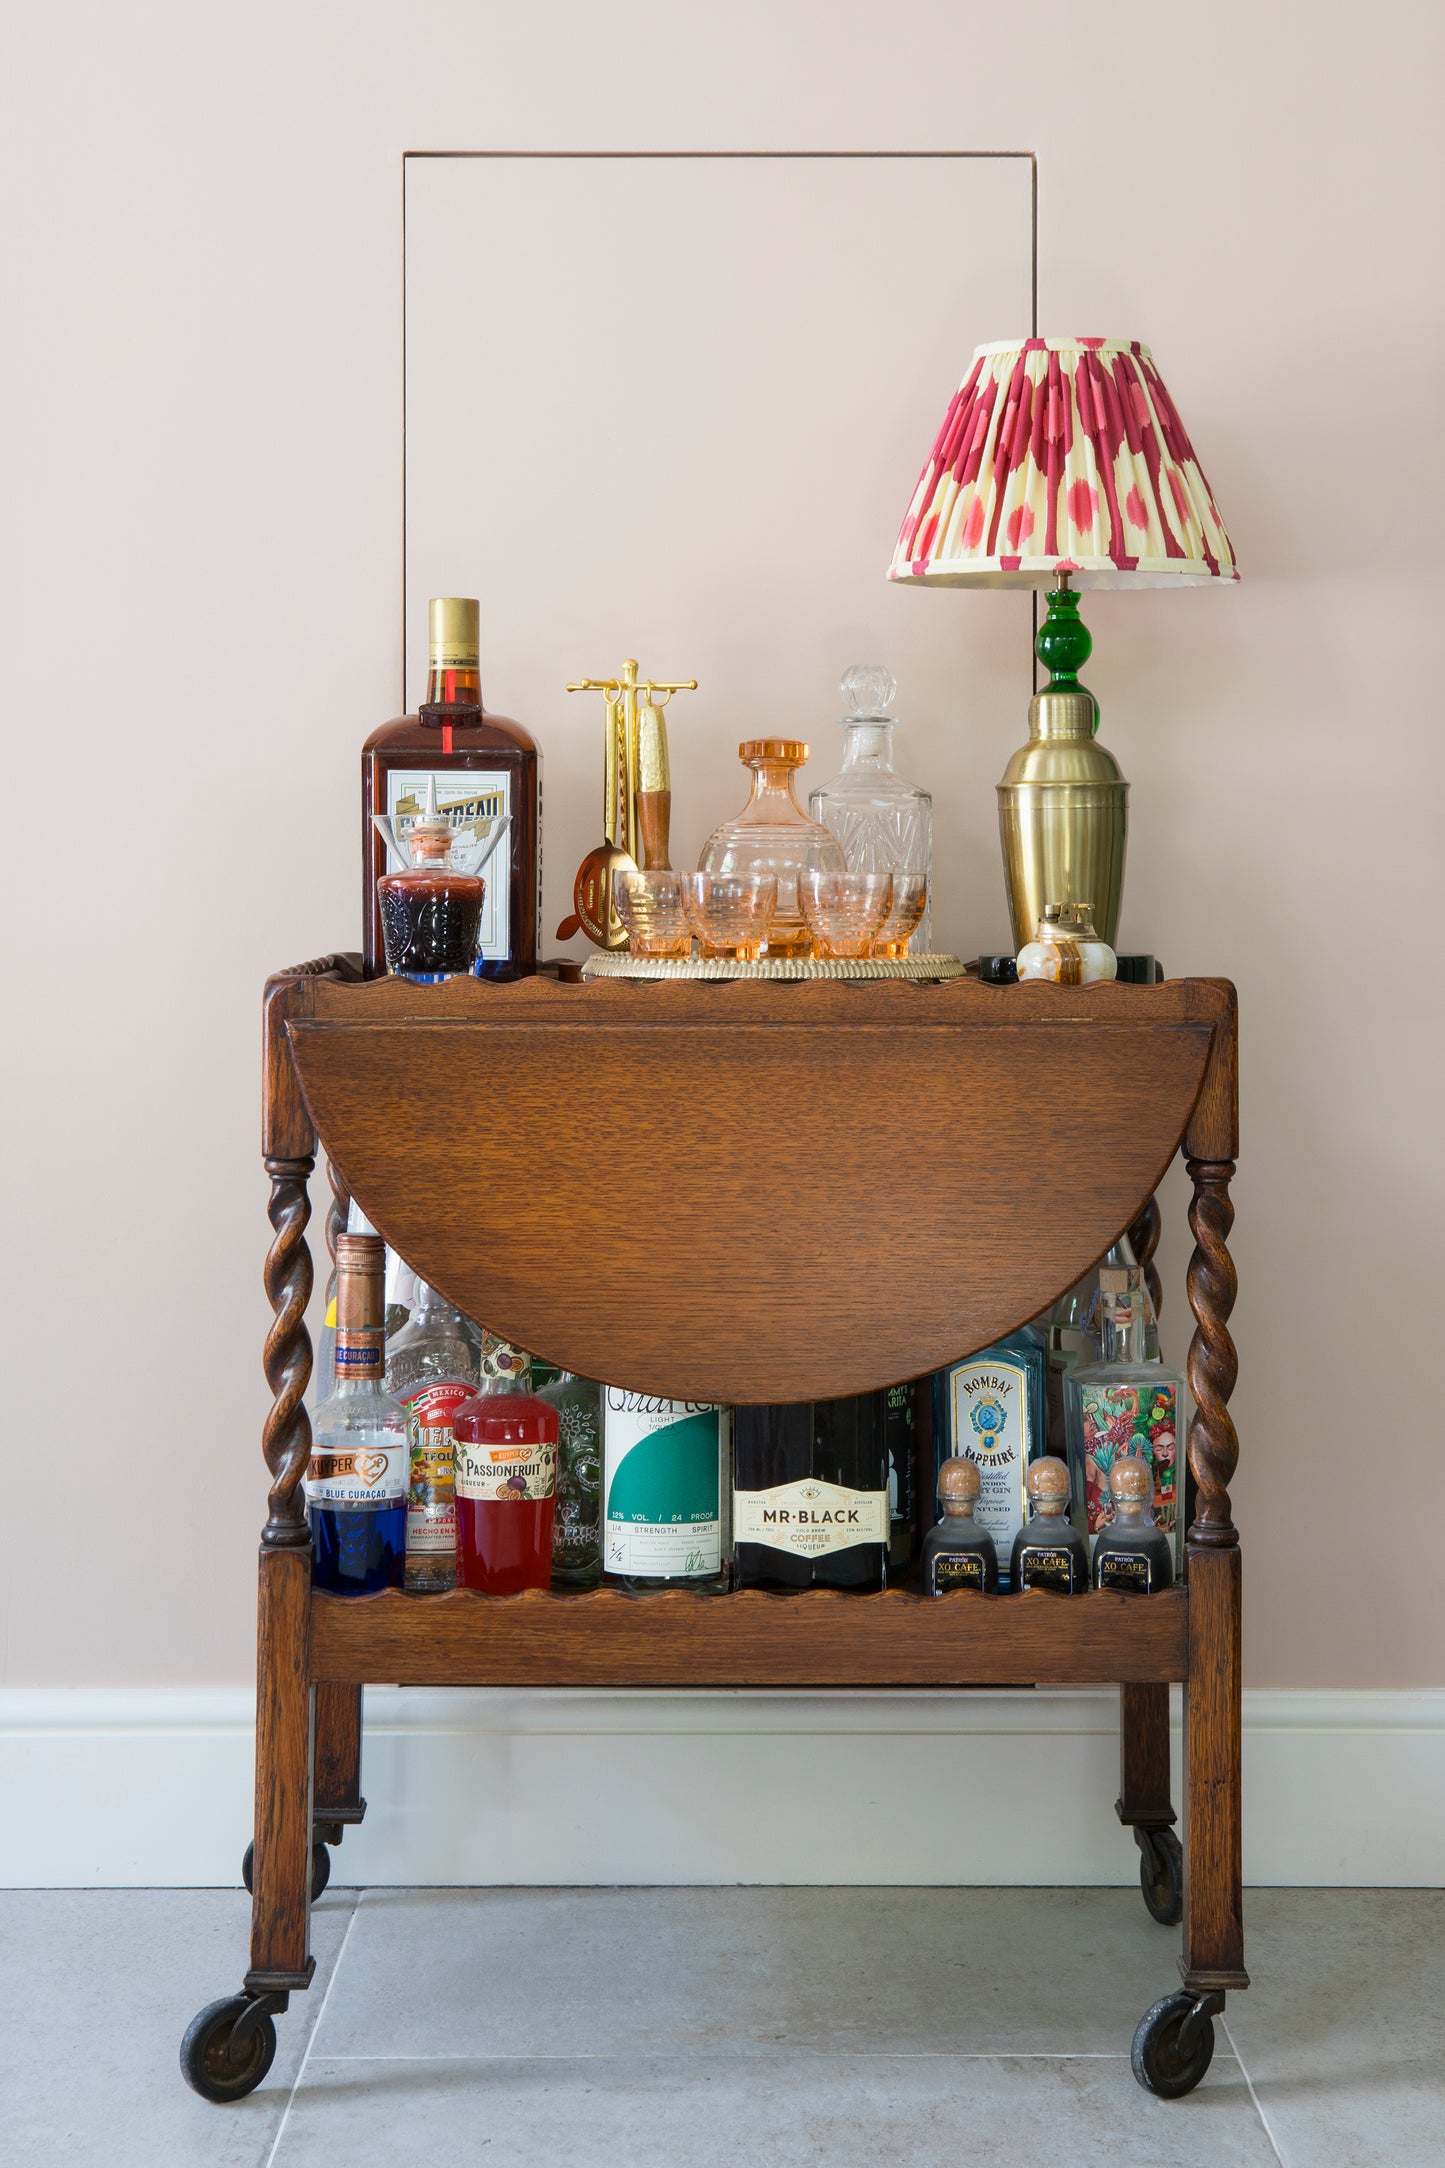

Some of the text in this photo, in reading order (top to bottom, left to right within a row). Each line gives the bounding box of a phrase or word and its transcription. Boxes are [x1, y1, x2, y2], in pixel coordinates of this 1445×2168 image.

[344, 1352, 376, 1362] CURAÇAO
[963, 1376, 1013, 1398] BOMBAY
[432, 1389, 464, 1398] MEXICO
[424, 1452, 454, 1462] TEQU
[499, 1450, 519, 1460] KUYPER
[962, 1445, 1016, 1466] SAPPHIRE
[311, 1458, 352, 1475] KUYPER
[326, 1489, 345, 1498] BLUE
[348, 1489, 386, 1500] CURAÇAO
[612, 1511, 624, 1520] 12%
[690, 1512, 714, 1520] PROOF
[692, 1525, 714, 1534] SPIRIT
[790, 1534, 831, 1542] COFFEE
[938, 1563, 979, 1571] XO CAFE
[1026, 1558, 1067, 1566] XO CAFE
[1104, 1562, 1144, 1572] XO CAFE
